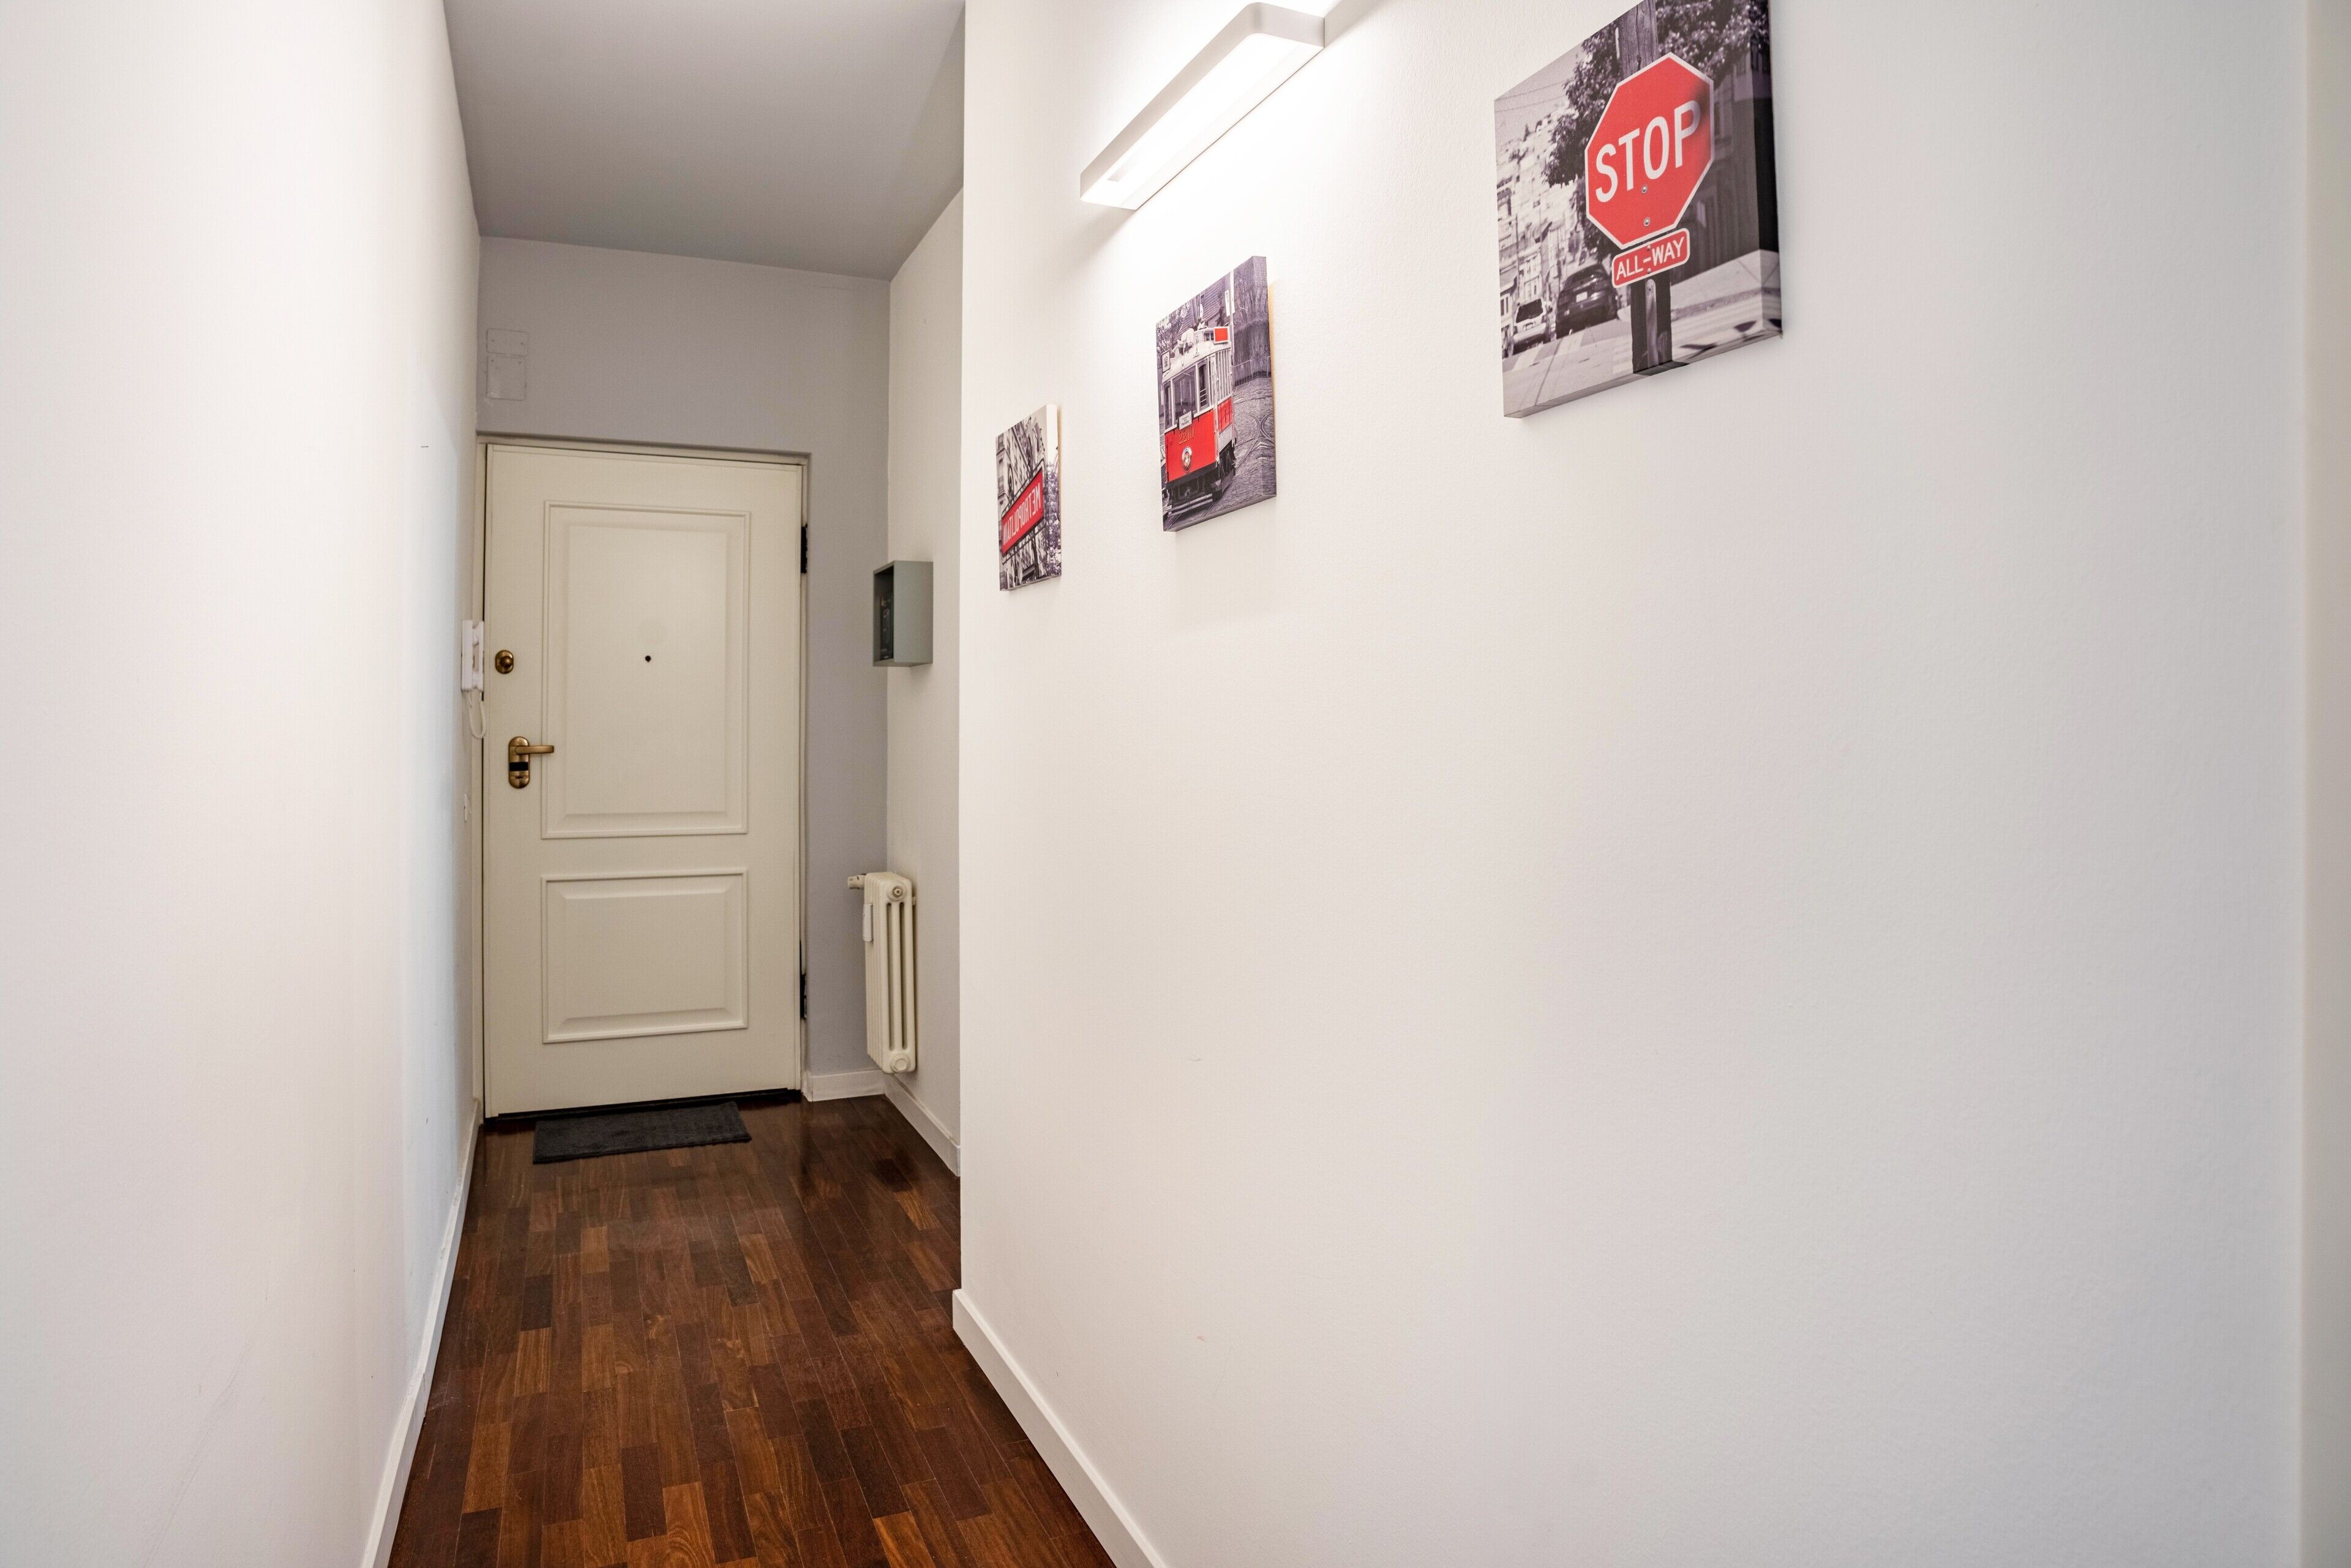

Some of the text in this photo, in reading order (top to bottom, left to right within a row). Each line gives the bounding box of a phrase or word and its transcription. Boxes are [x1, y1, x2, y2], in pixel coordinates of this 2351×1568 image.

[1595, 100, 1701, 203] STOP
[1616, 236, 1685, 281] ALL-WAY
[1179, 426, 1195, 445] 2210
